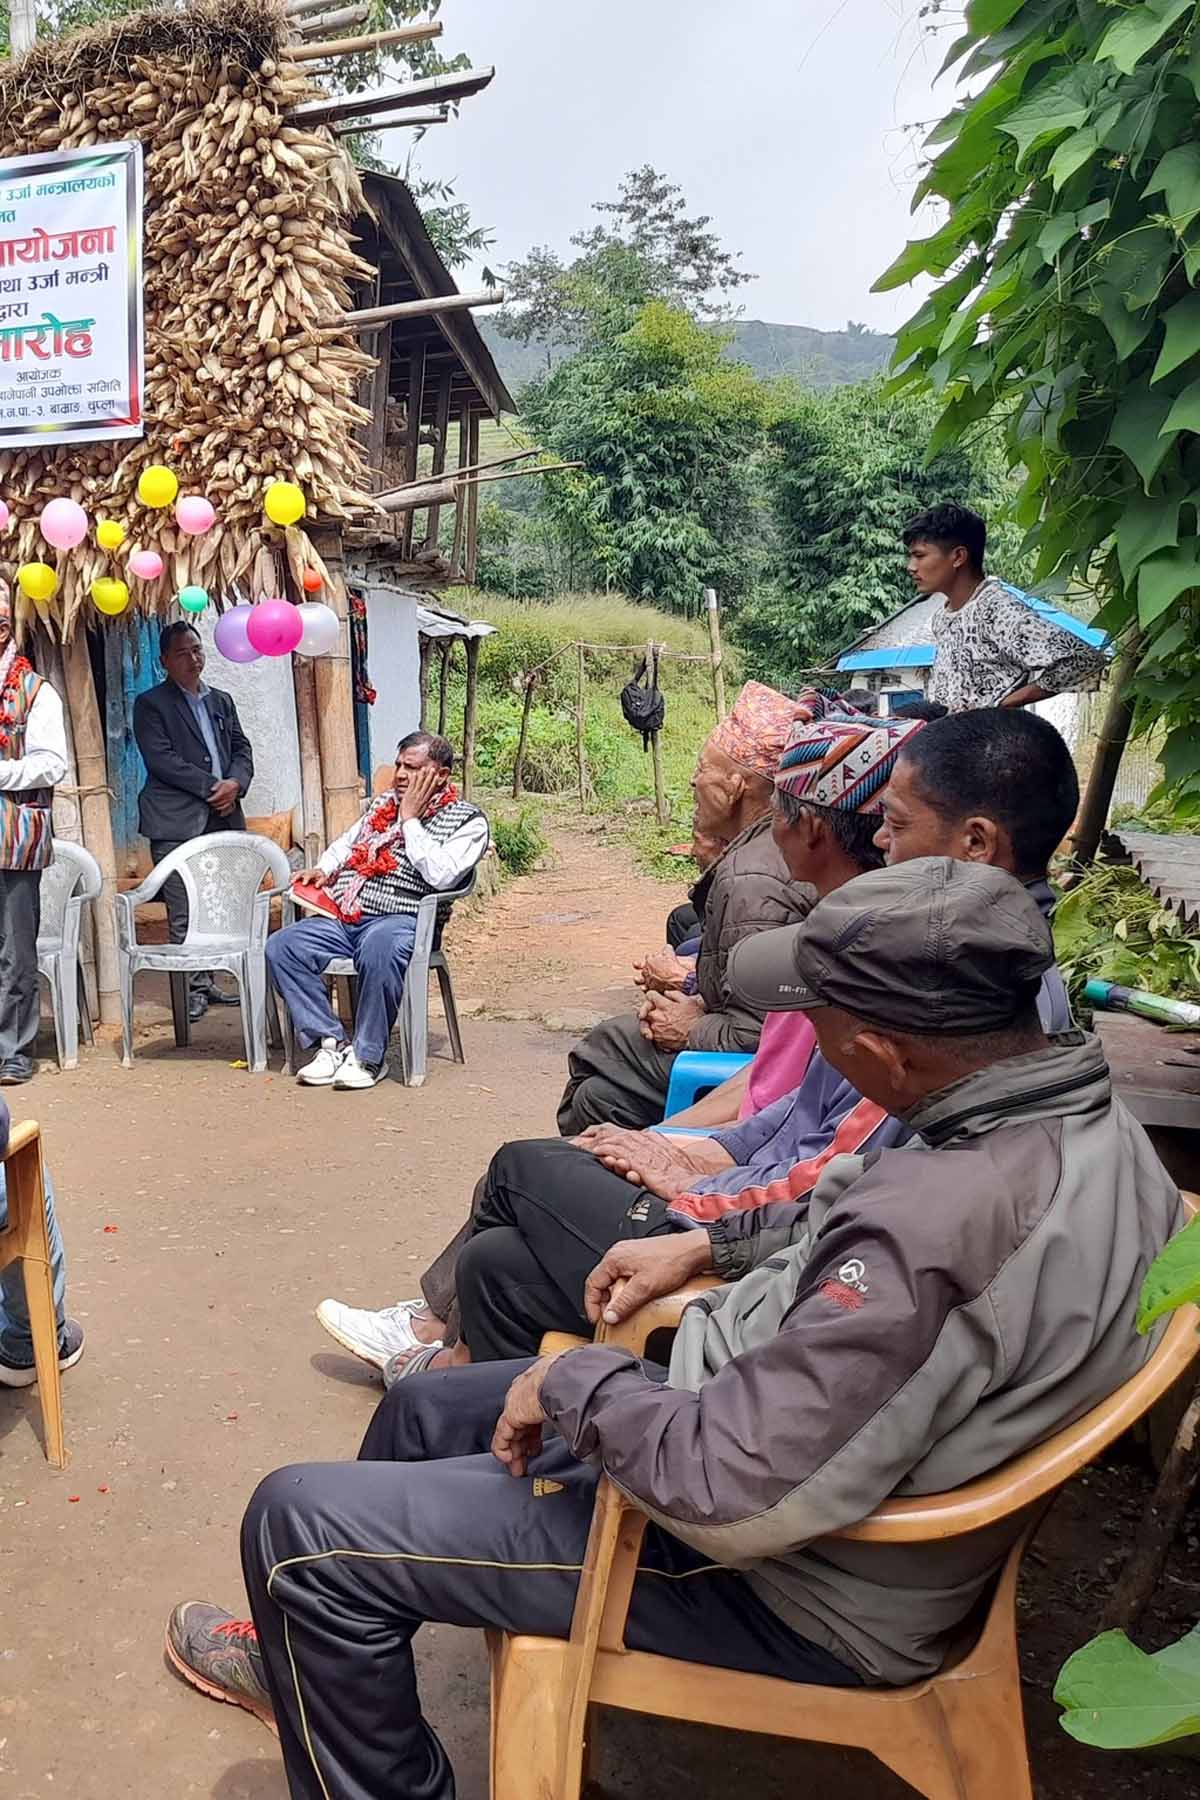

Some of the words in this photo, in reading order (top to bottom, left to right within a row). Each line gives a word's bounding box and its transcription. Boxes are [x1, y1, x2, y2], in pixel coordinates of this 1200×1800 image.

[6, 183, 32, 201] उर्जा
[36, 172, 117, 196] मन्त्रालयको
[27, 268, 60, 291] उर्जा
[65, 261, 109, 285] मन्त्री
[15, 367, 63, 383] आयोजक
[41, 382, 83, 398] उपभोक्ता
[87, 378, 123, 394] समिति
